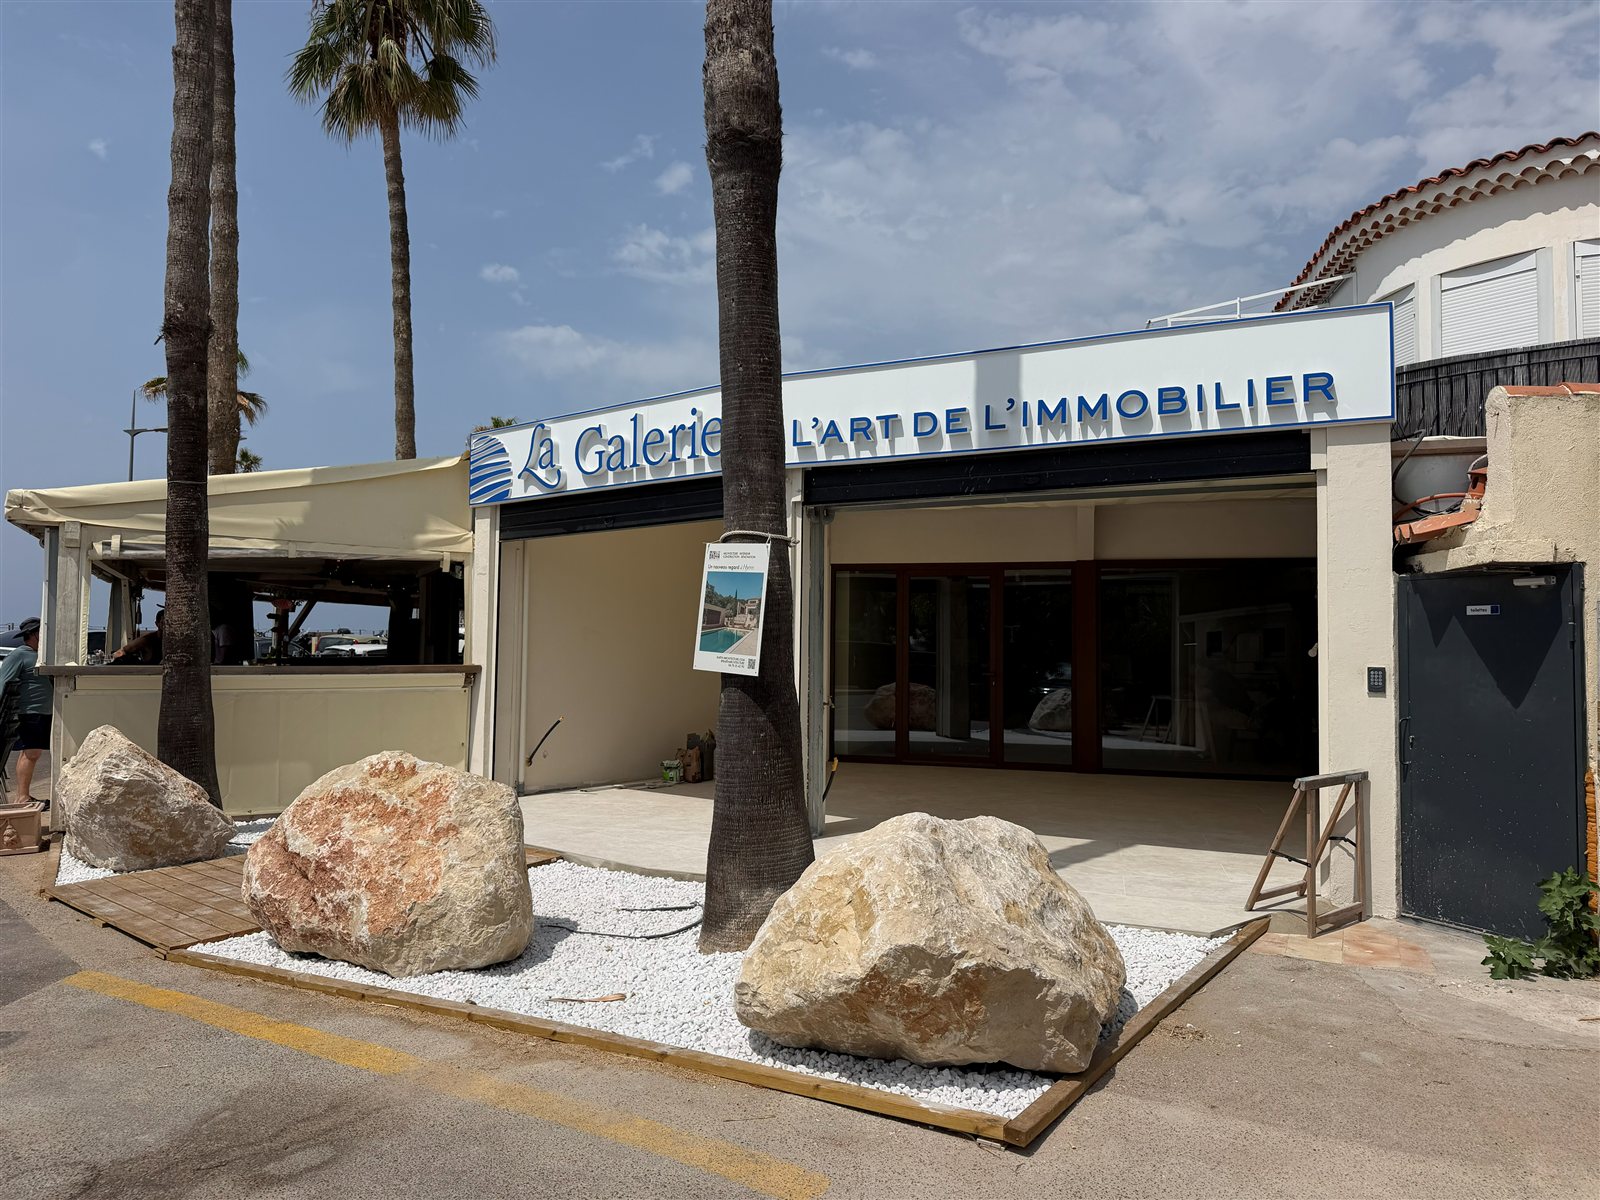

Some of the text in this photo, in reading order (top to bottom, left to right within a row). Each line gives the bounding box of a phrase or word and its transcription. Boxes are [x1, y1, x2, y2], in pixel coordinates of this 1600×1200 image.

[517, 407, 722, 489] La Galerie
[792, 371, 1336, 448] L'ART DE L'IMMOBILIER
